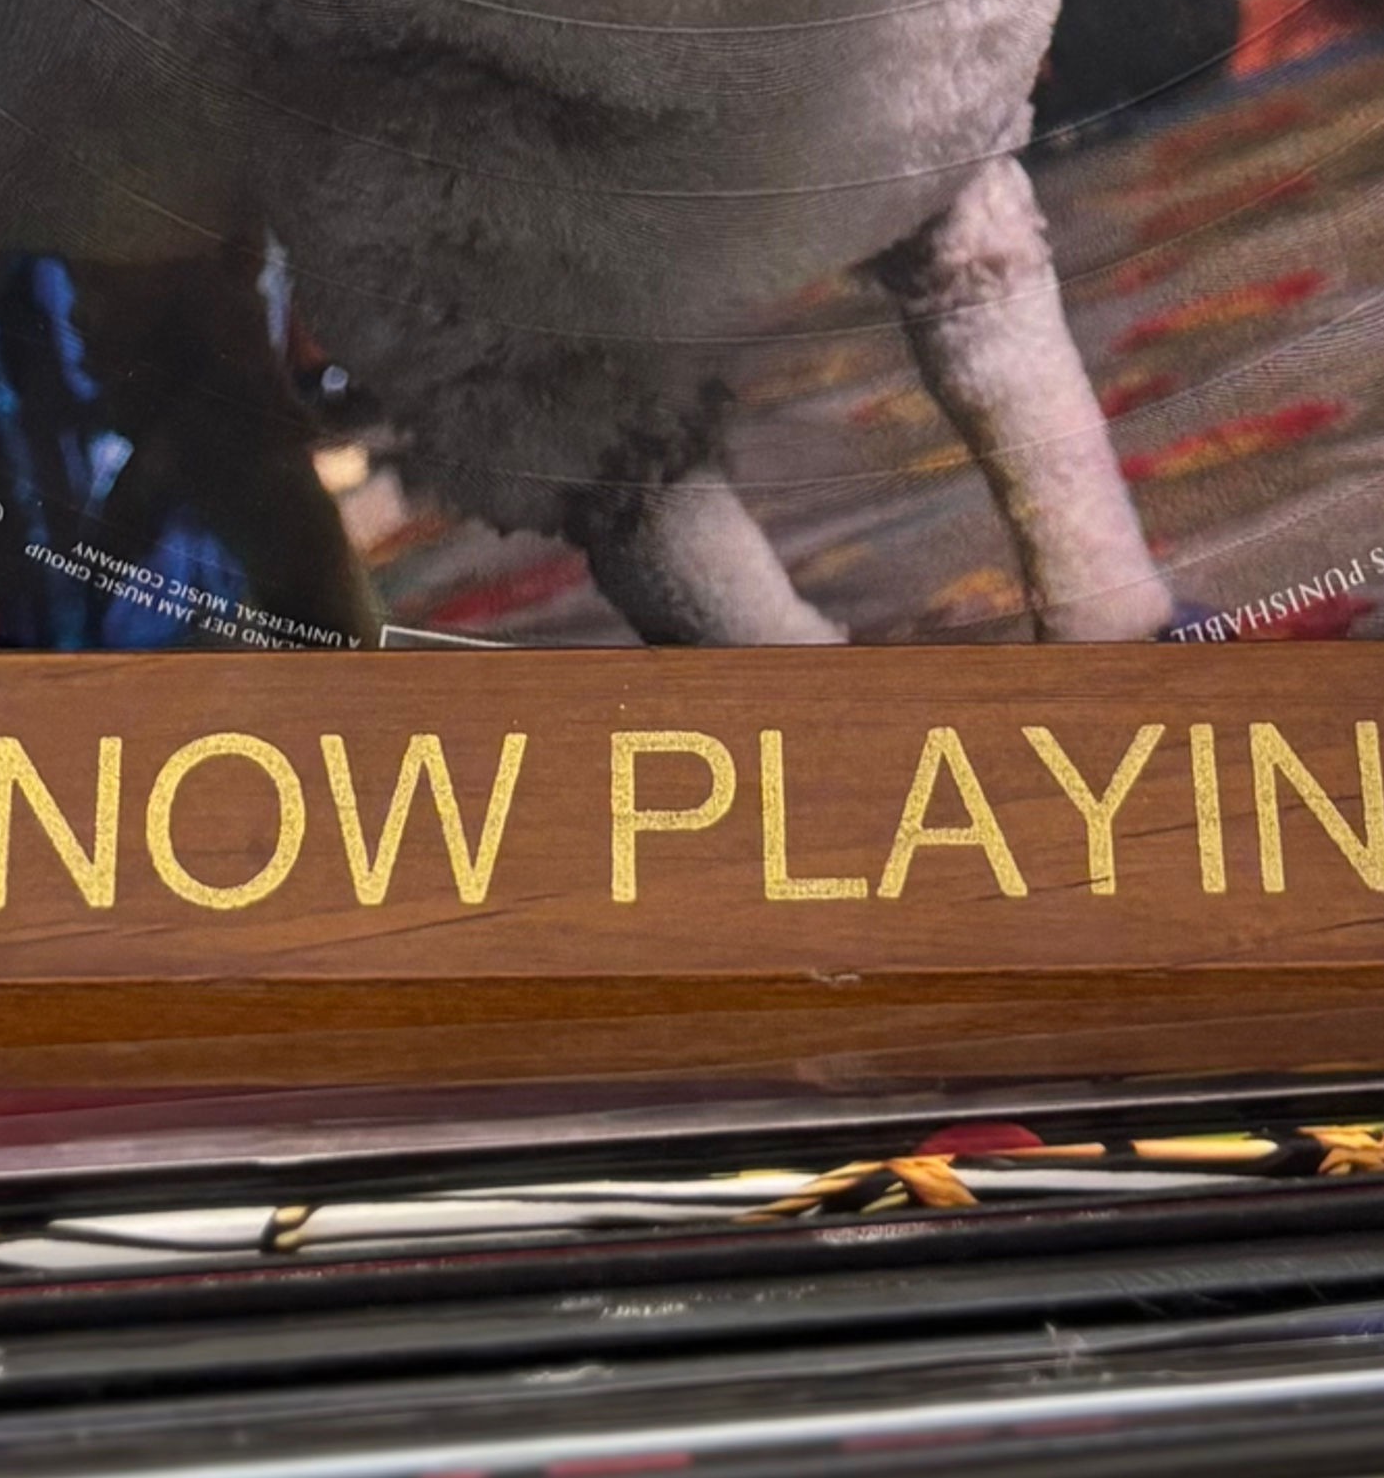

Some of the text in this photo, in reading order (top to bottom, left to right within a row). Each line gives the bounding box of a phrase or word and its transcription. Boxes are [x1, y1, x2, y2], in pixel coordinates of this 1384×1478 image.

[24, 542, 91, 583] GROUP
[70, 539, 165, 590] COMPANY
[93, 570, 154, 607] MUSIC
[167, 578, 229, 614] MUSIC
[157, 598, 195, 624] JAM
[198, 615, 238, 640] DEF
[233, 600, 343, 647] UNIVERSAL
